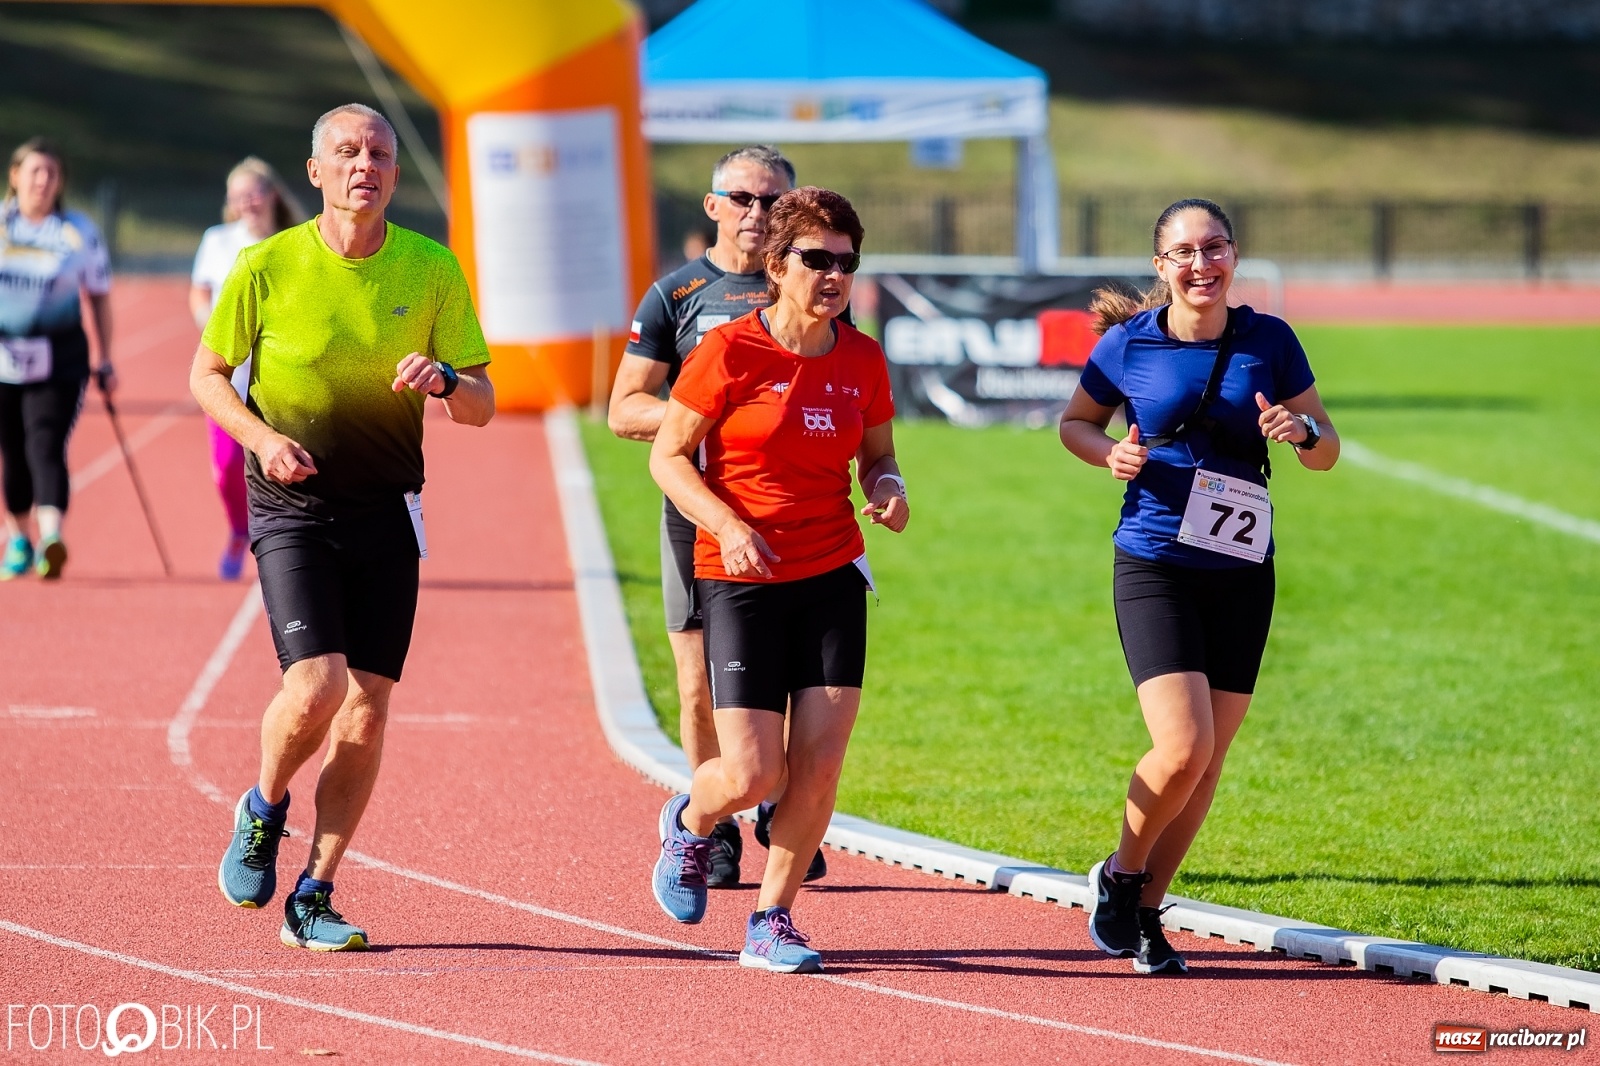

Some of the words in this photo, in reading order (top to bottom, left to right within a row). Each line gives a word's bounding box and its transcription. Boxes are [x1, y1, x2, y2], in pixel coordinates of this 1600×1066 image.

[391, 305, 410, 317] 4F
[770, 382, 790, 393] 4F
[803, 412, 836, 431] bbl
[1209, 502, 1257, 545] 72
